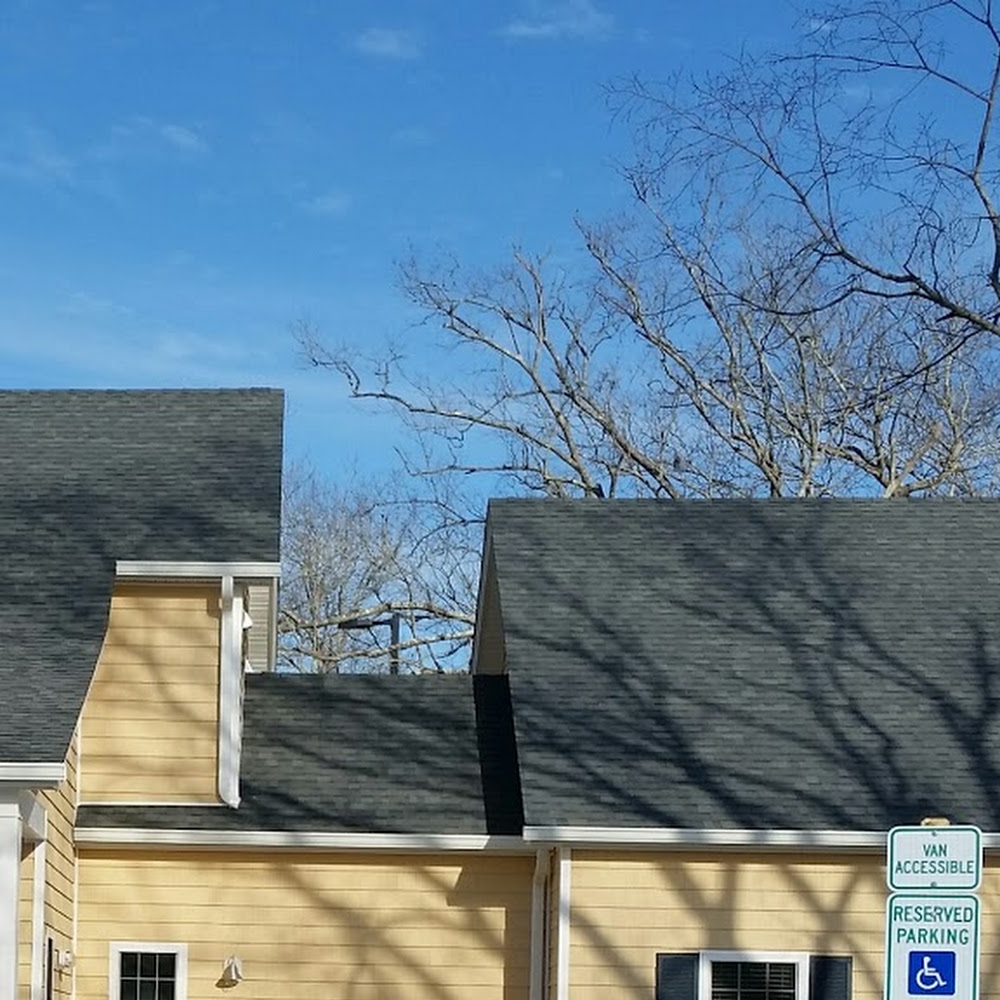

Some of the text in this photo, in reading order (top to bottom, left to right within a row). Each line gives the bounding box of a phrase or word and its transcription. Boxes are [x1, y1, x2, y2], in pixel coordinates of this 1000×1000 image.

[923, 844, 947, 857] VAN
[895, 860, 974, 874] ACCESSIBLE
[894, 906, 973, 923] RESERVED
[897, 929, 969, 945] PARKING
